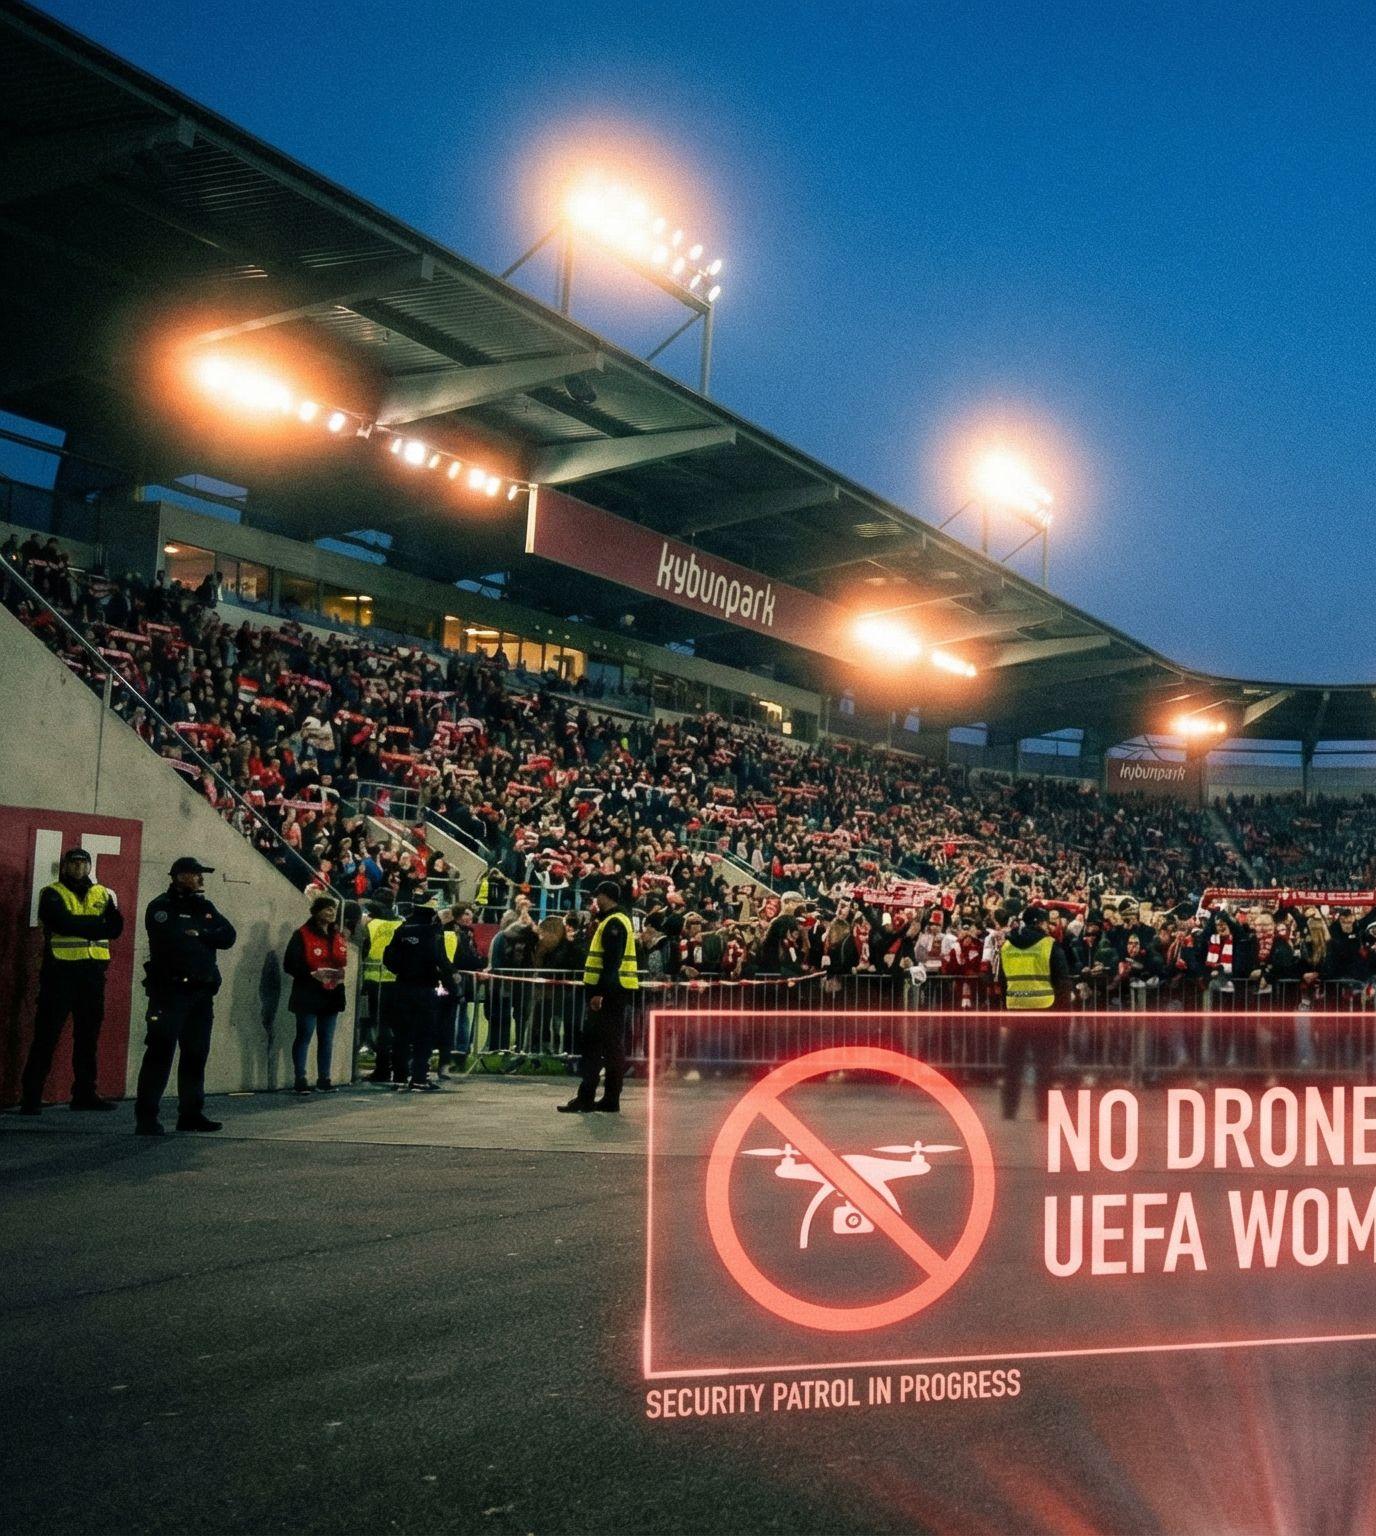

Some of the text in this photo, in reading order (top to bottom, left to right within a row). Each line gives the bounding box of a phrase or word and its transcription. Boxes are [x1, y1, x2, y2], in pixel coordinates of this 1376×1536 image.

[656, 541, 776, 627] kybunpark
[1046, 1088, 1139, 1173] NO
[1044, 1191, 1208, 1278] UEFA
[645, 1368, 1021, 1419] SECURITY PATROL IN PROGRESS
